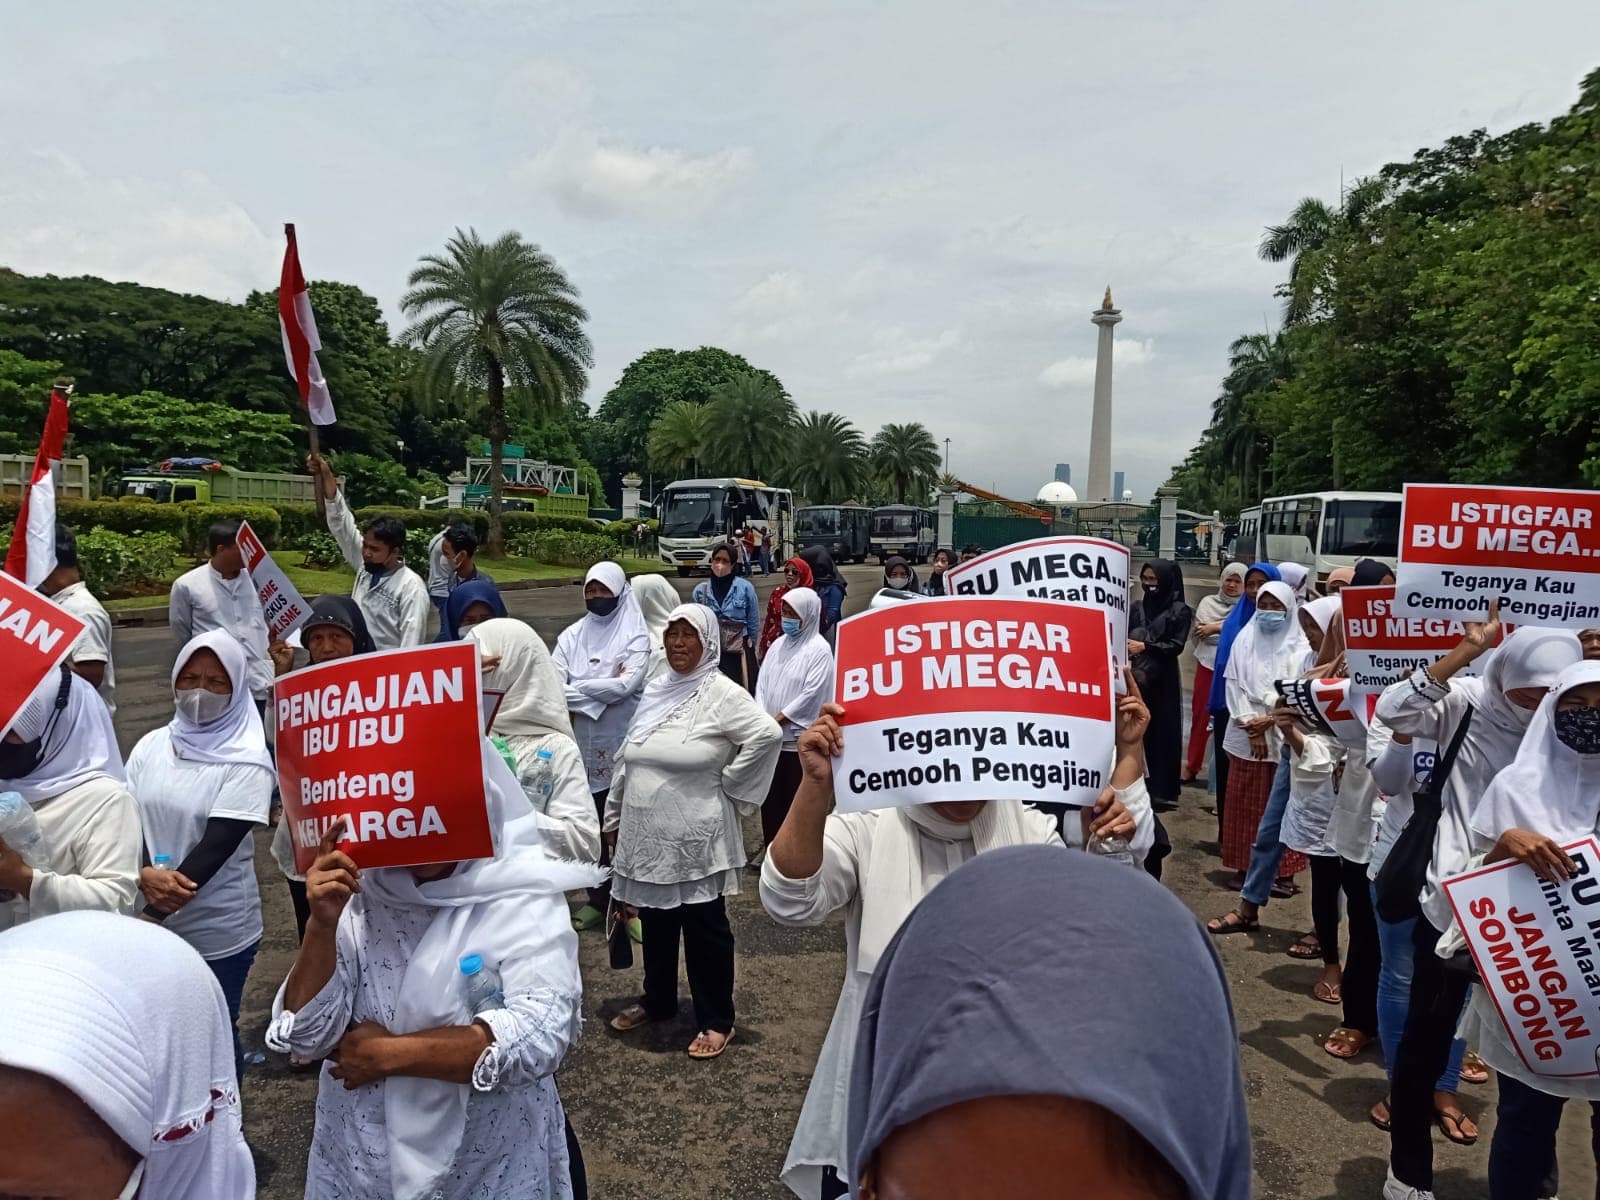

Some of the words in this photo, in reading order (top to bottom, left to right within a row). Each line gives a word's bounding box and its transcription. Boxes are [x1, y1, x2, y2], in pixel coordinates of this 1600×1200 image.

[1450, 502, 1592, 528] ISTIGFAR
[1412, 524, 1463, 549] BU
[1010, 552, 1126, 589] MEGA...
[1441, 571, 1527, 594] Teganya
[1534, 576, 1576, 594] Kau
[1094, 586, 1126, 613] Donk
[1407, 592, 1490, 611] Cemooh
[1498, 596, 1599, 622] Pengajian
[884, 619, 1071, 656] ISTIGFAR
[1348, 618, 1378, 638] BU
[843, 660, 904, 702] BU
[921, 653, 1101, 697] MEGA...
[1368, 655, 1429, 671] Teganya
[278, 667, 464, 731] PENGAJIAN
[303, 723, 340, 757] IBU
[348, 713, 404, 749] IBU
[883, 726, 1007, 755] Teganya
[1017, 722, 1070, 750] Kau
[301, 770, 415, 806] Benteng
[849, 759, 961, 794] Cemooh
[972, 757, 1101, 791] Pengajian
[1469, 897, 1563, 1061] SOMBONG
[1507, 906, 1592, 1040] JANGAN
